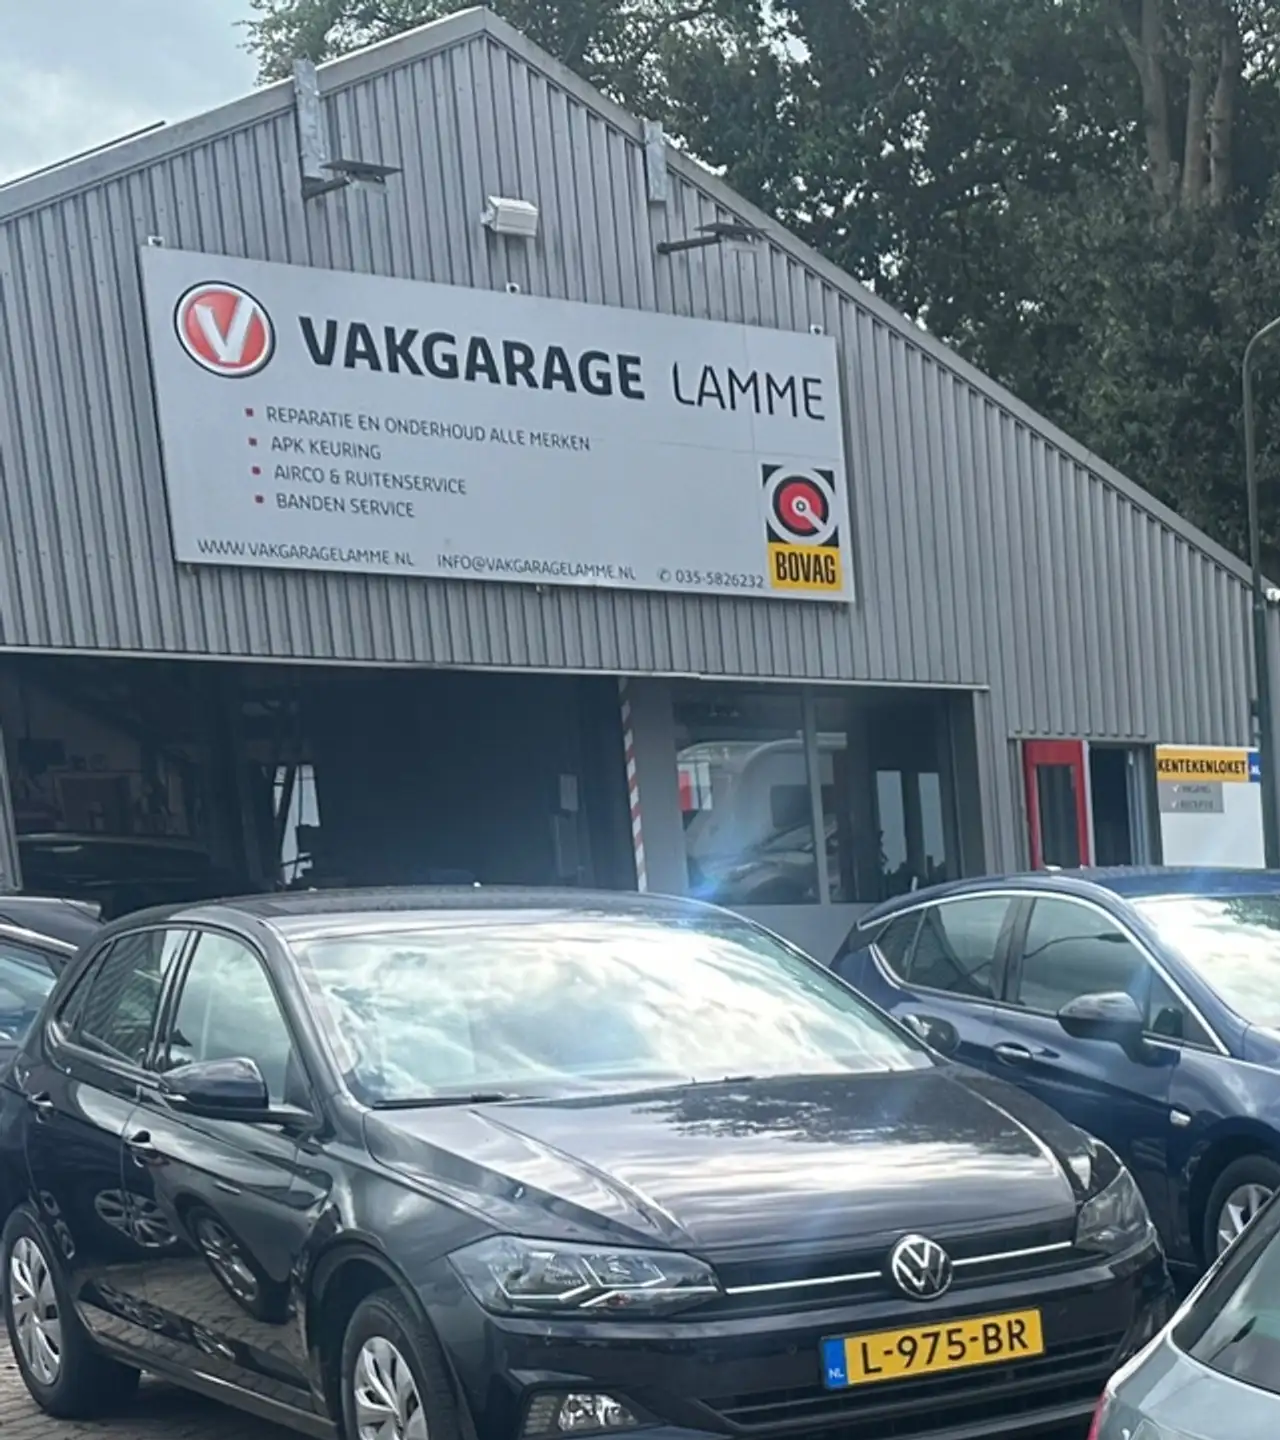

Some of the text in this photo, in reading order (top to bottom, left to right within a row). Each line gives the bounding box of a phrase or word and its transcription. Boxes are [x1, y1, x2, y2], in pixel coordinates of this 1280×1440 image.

[298, 315, 826, 421] VAKGARAGE LAMME
[265, 405, 591, 451] REPARATIE EN ONDERHOUD ALLE MERKEN
[270, 436, 382, 460] APK KEURING
[273, 464, 467, 496] AIRCO & RUITENSERVICE
[275, 492, 416, 518] BANDEN SERVICE
[436, 553, 637, 581] INFO@VAKGARAGELAMME.NL
[674, 568, 765, 589] 035-5826232
[774, 551, 837, 585] BOVAG
[1157, 758, 1247, 775] KENTEKENLOKET
[828, 1318, 1029, 1379] NL L-975-BR
